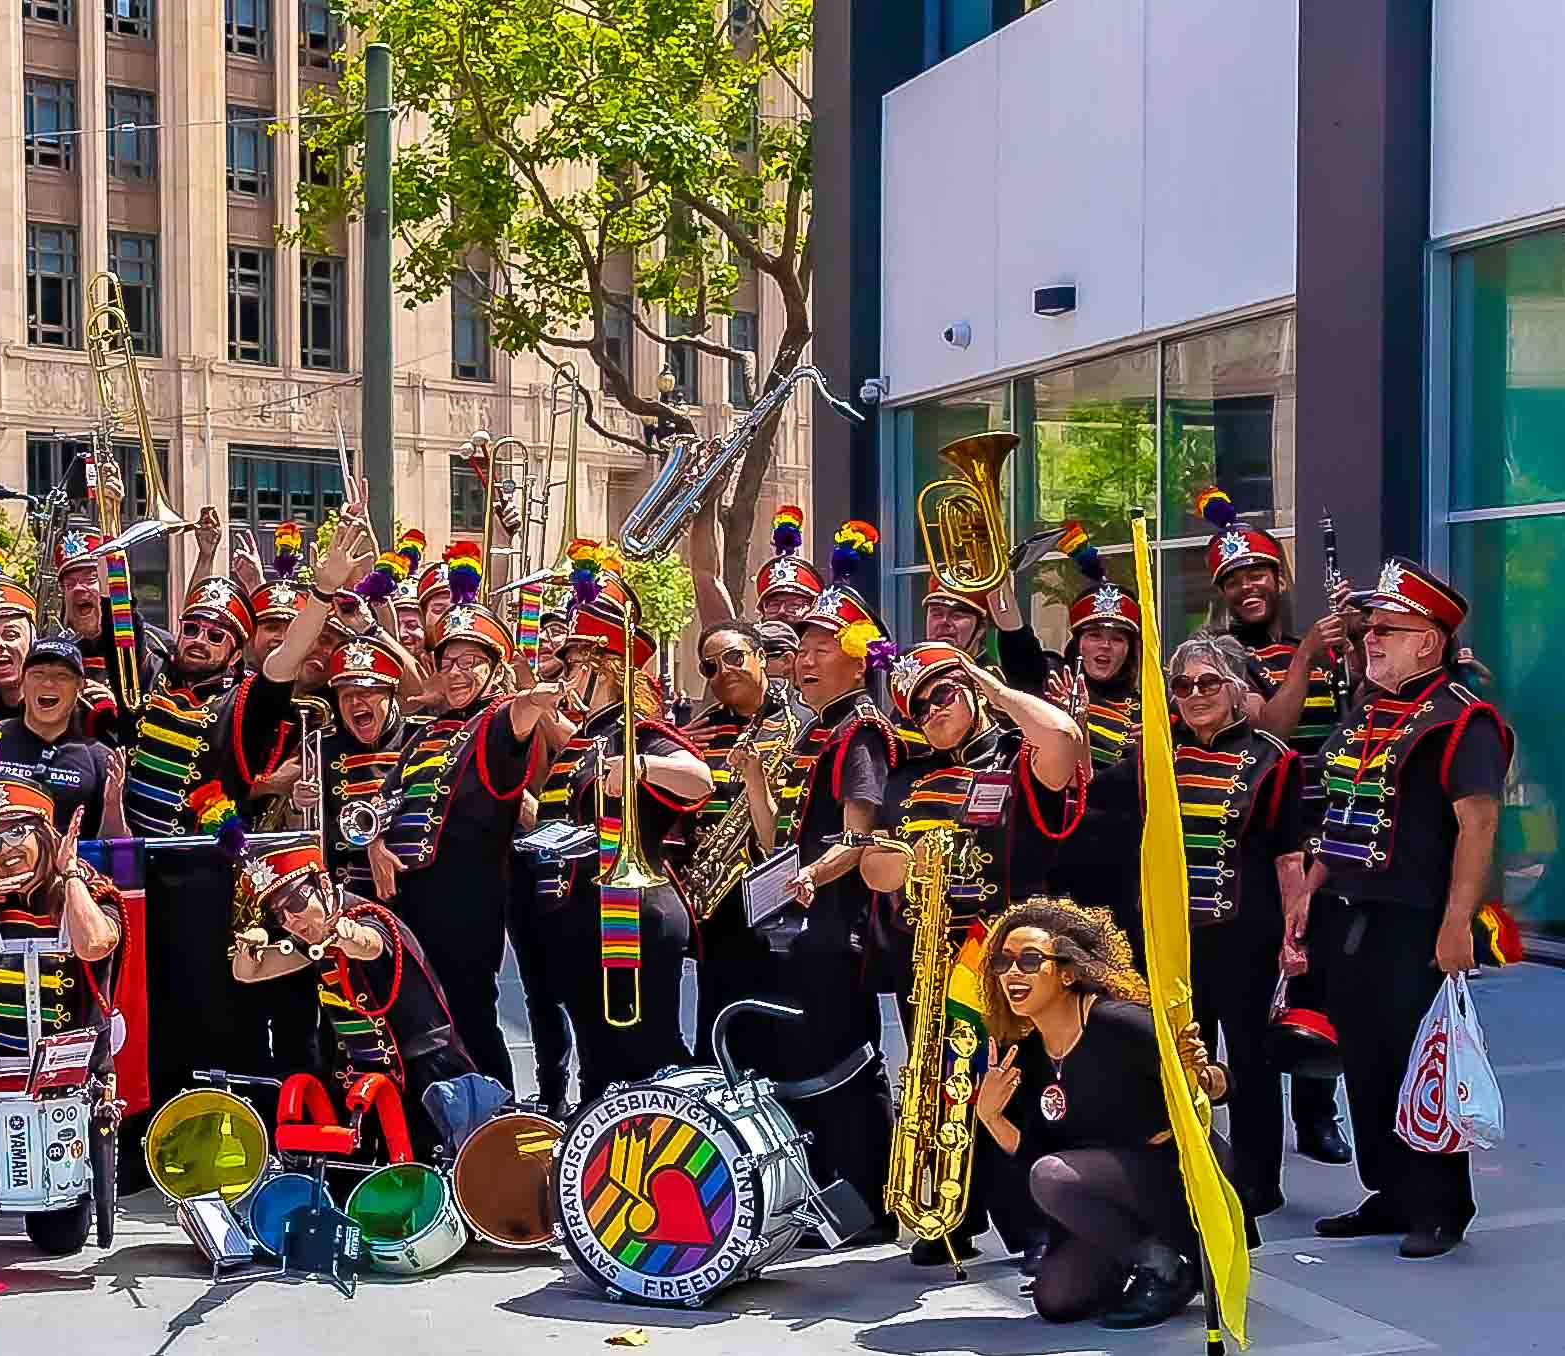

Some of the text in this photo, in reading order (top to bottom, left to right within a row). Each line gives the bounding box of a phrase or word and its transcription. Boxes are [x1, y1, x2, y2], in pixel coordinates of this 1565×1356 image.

[8, 1133, 29, 1188] YAMAHA
[594, 1093, 724, 1136] LESBIAN/GAY
[562, 1123, 621, 1280] SAN FRANCISCO
[643, 1155, 755, 1298] FREEDOM BAND
